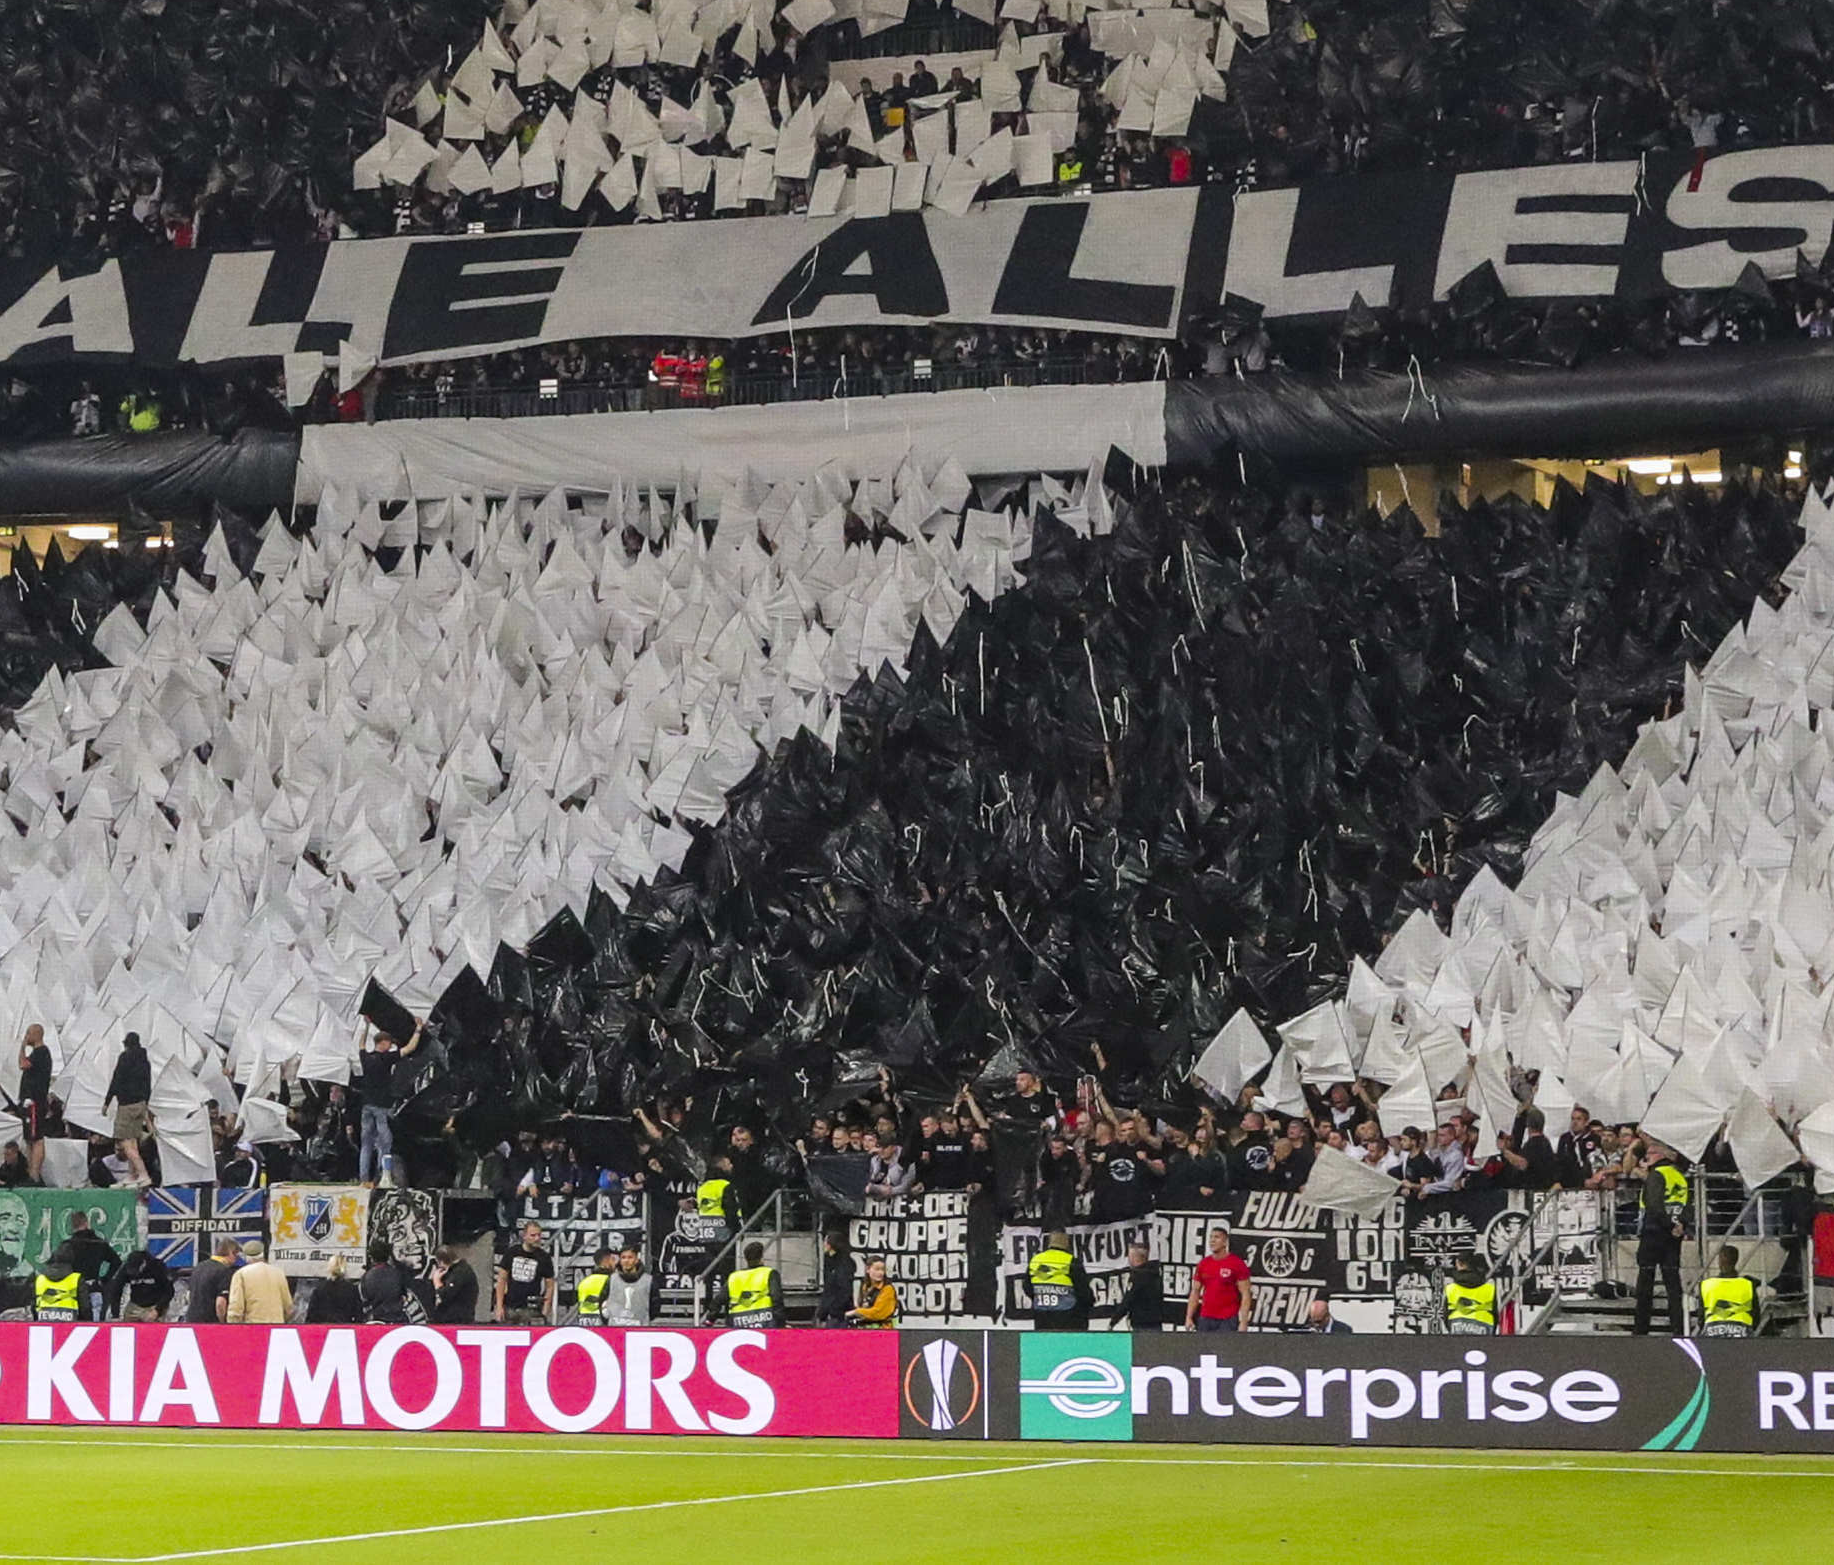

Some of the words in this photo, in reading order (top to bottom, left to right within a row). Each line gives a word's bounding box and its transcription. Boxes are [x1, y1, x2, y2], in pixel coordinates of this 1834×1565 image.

[524, 1193, 638, 1219] LTRAS
[1239, 1192, 1320, 1231] FULDA
[171, 1218, 241, 1233] DIFFIDATI
[849, 1217, 968, 1251] GRUPPE
[1013, 1222, 1153, 1265] FRKFURT
[850, 1251, 968, 1280] SADION
[1300, 1248, 1315, 1272] 6
[1346, 1261, 1393, 1292] 64
[1037, 1294, 1059, 1307] 189
[27, 1326, 221, 1423] KIA
[258, 1325, 777, 1435] MOTORS
[1020, 1349, 1620, 1439] enterprise
